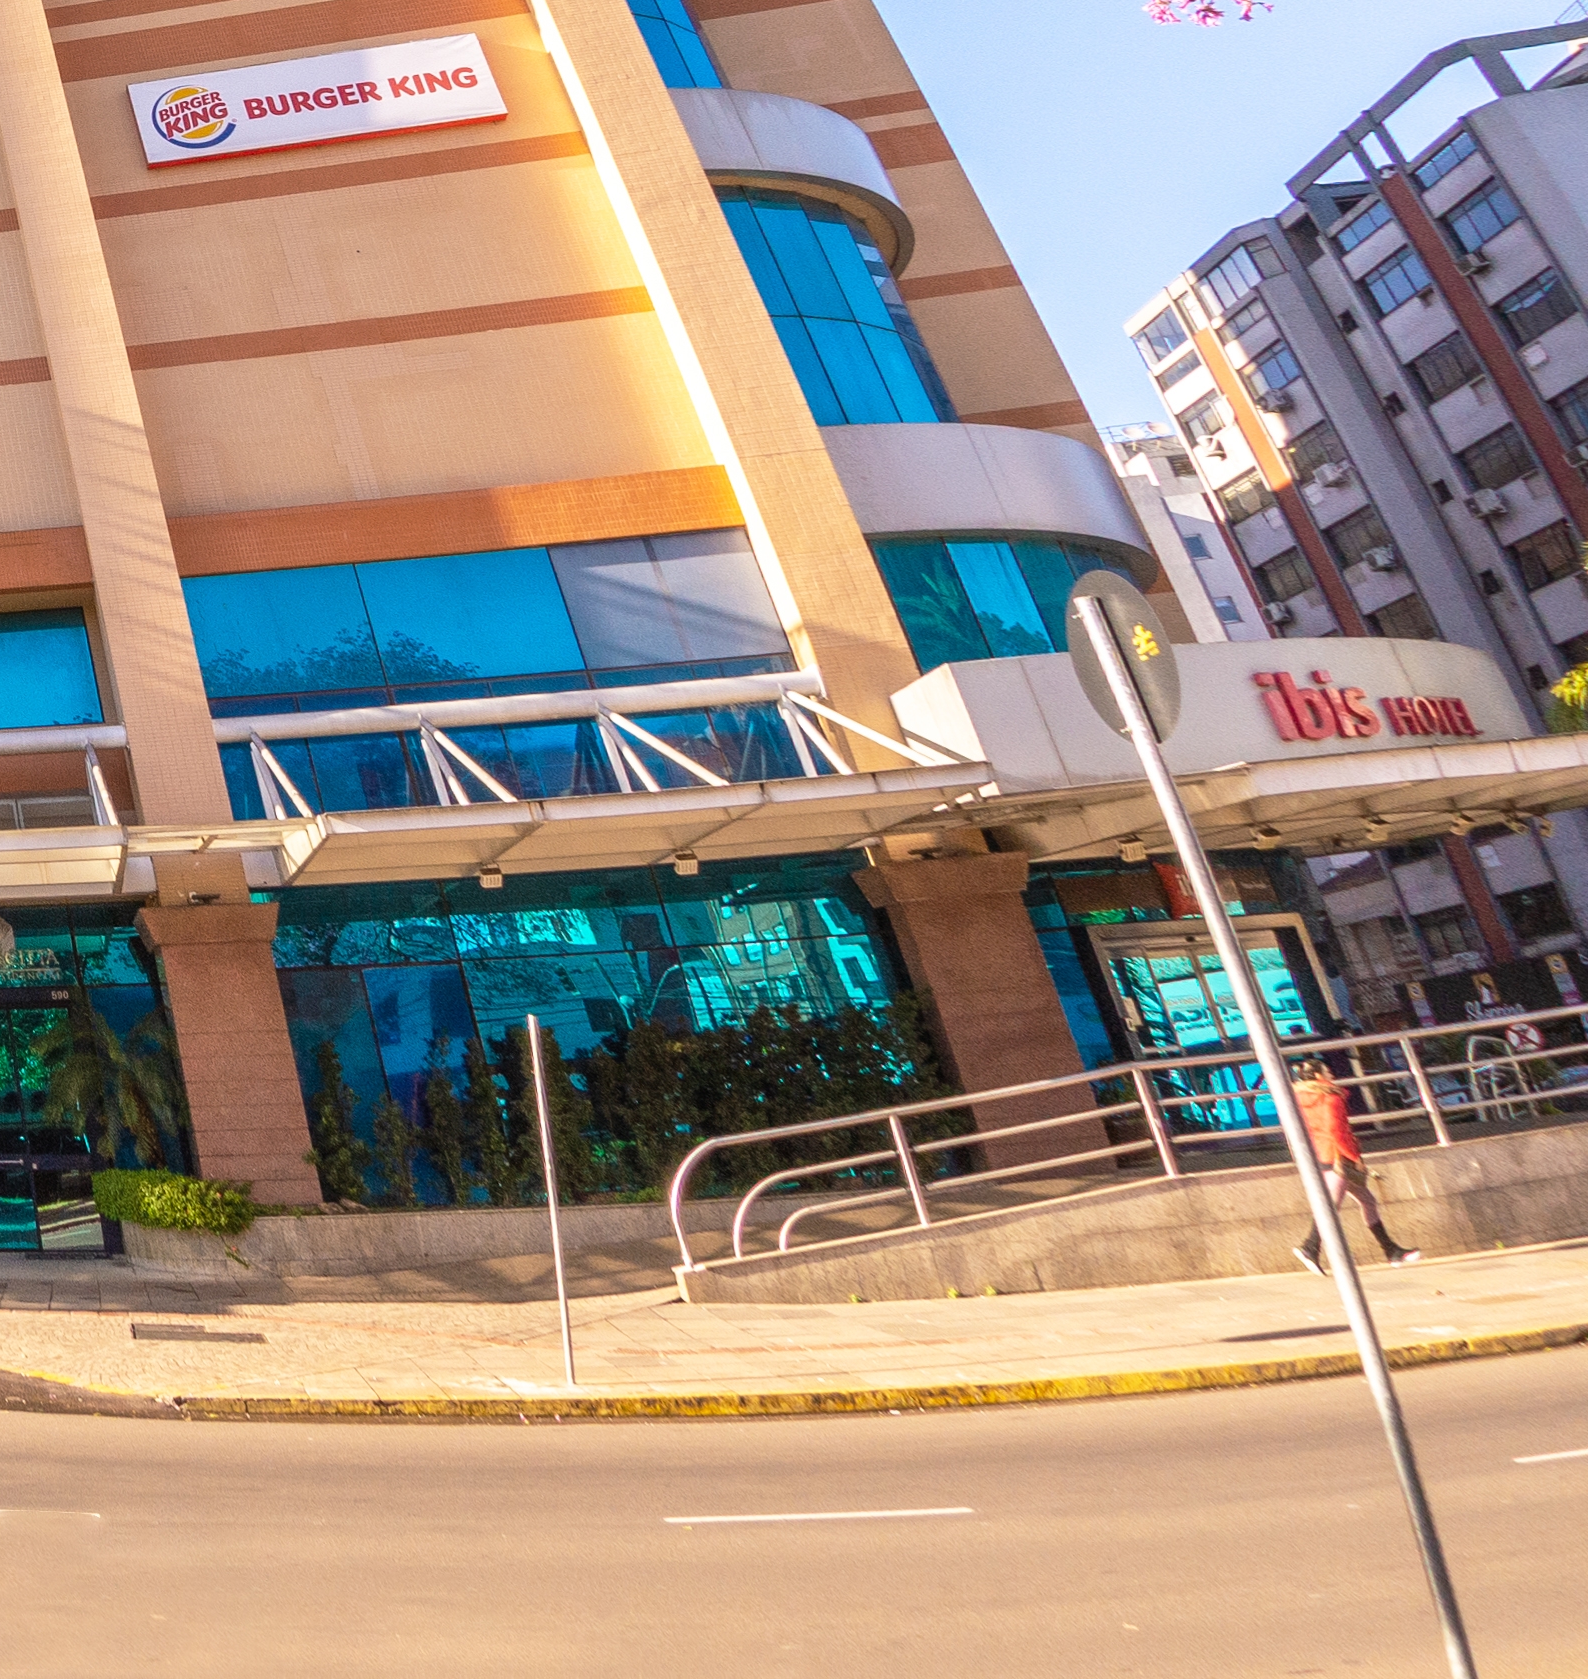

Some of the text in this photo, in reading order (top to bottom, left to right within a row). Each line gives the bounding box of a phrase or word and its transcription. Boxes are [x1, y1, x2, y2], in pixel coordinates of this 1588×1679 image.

[158, 90, 223, 124] BURGER
[243, 67, 479, 120] BURGER KING
[163, 102, 228, 140] KING
[1253, 670, 1485, 741] ibis HOTEL
[51, 990, 70, 1001] 590
